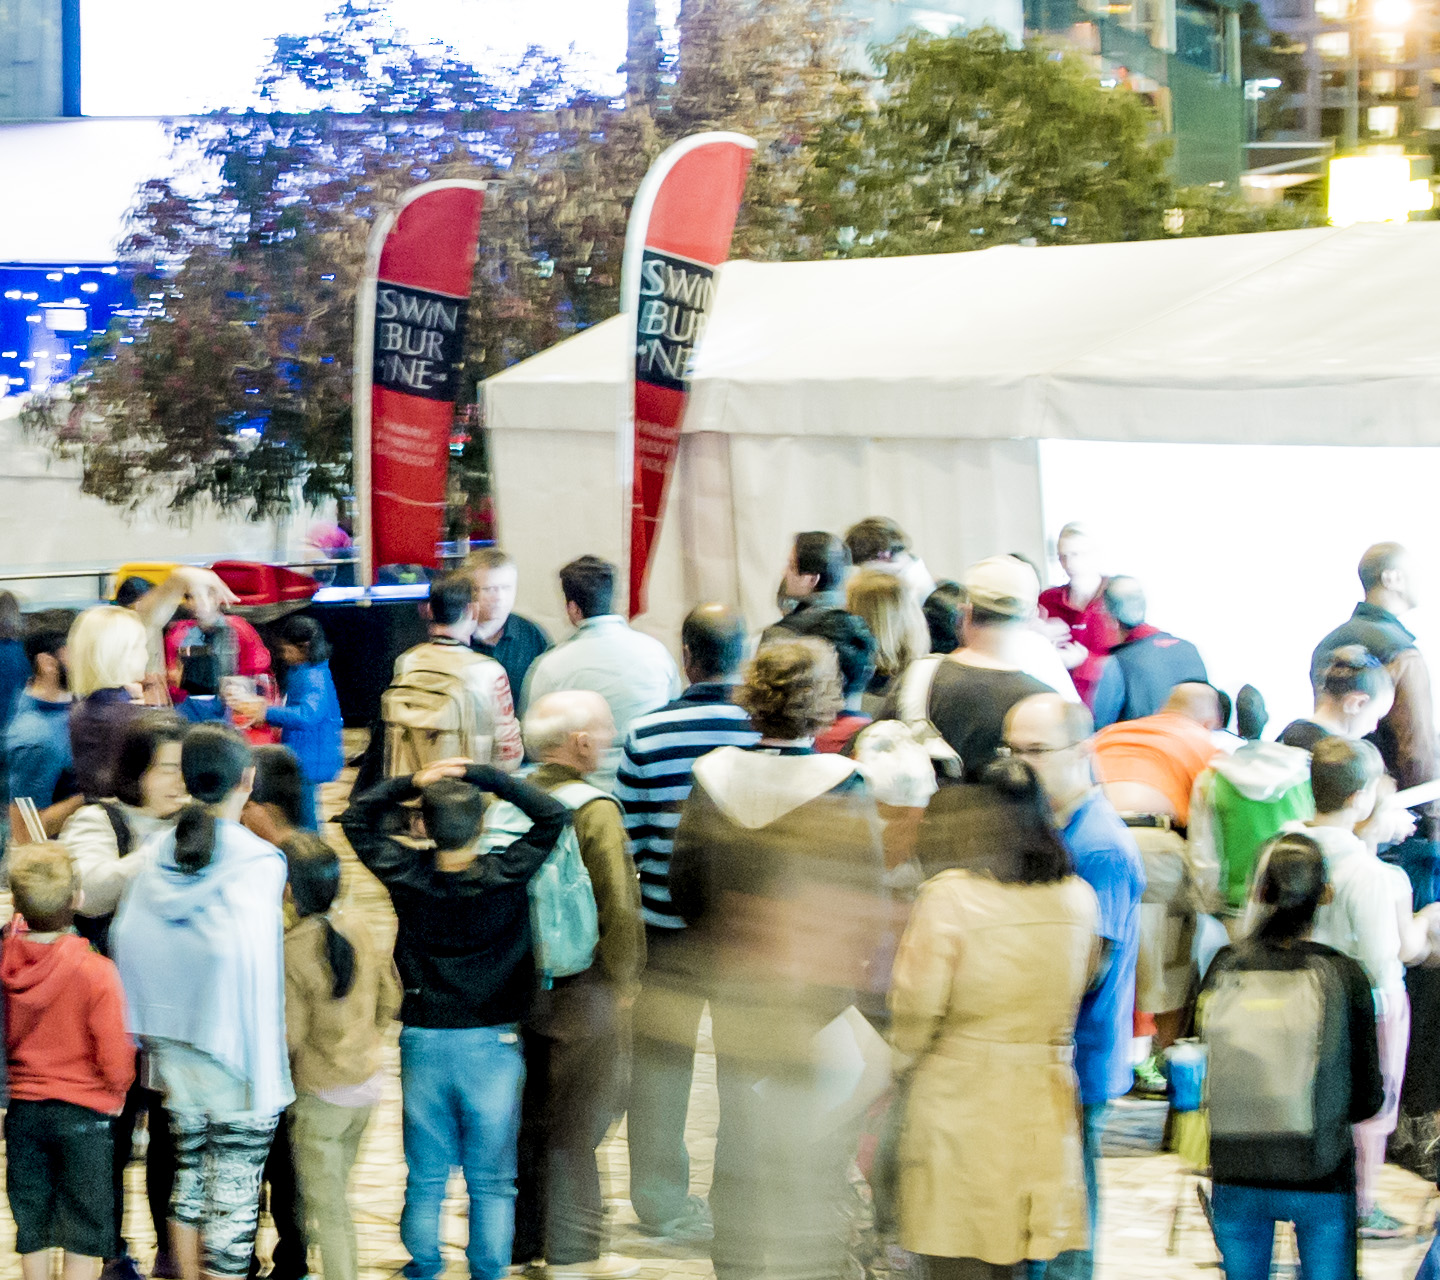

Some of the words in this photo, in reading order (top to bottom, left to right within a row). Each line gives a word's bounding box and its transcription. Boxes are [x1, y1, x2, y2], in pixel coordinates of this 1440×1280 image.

[378, 289, 459, 331] SWIN
[380, 322, 444, 361] BUR
[383, 353, 435, 389] NE
